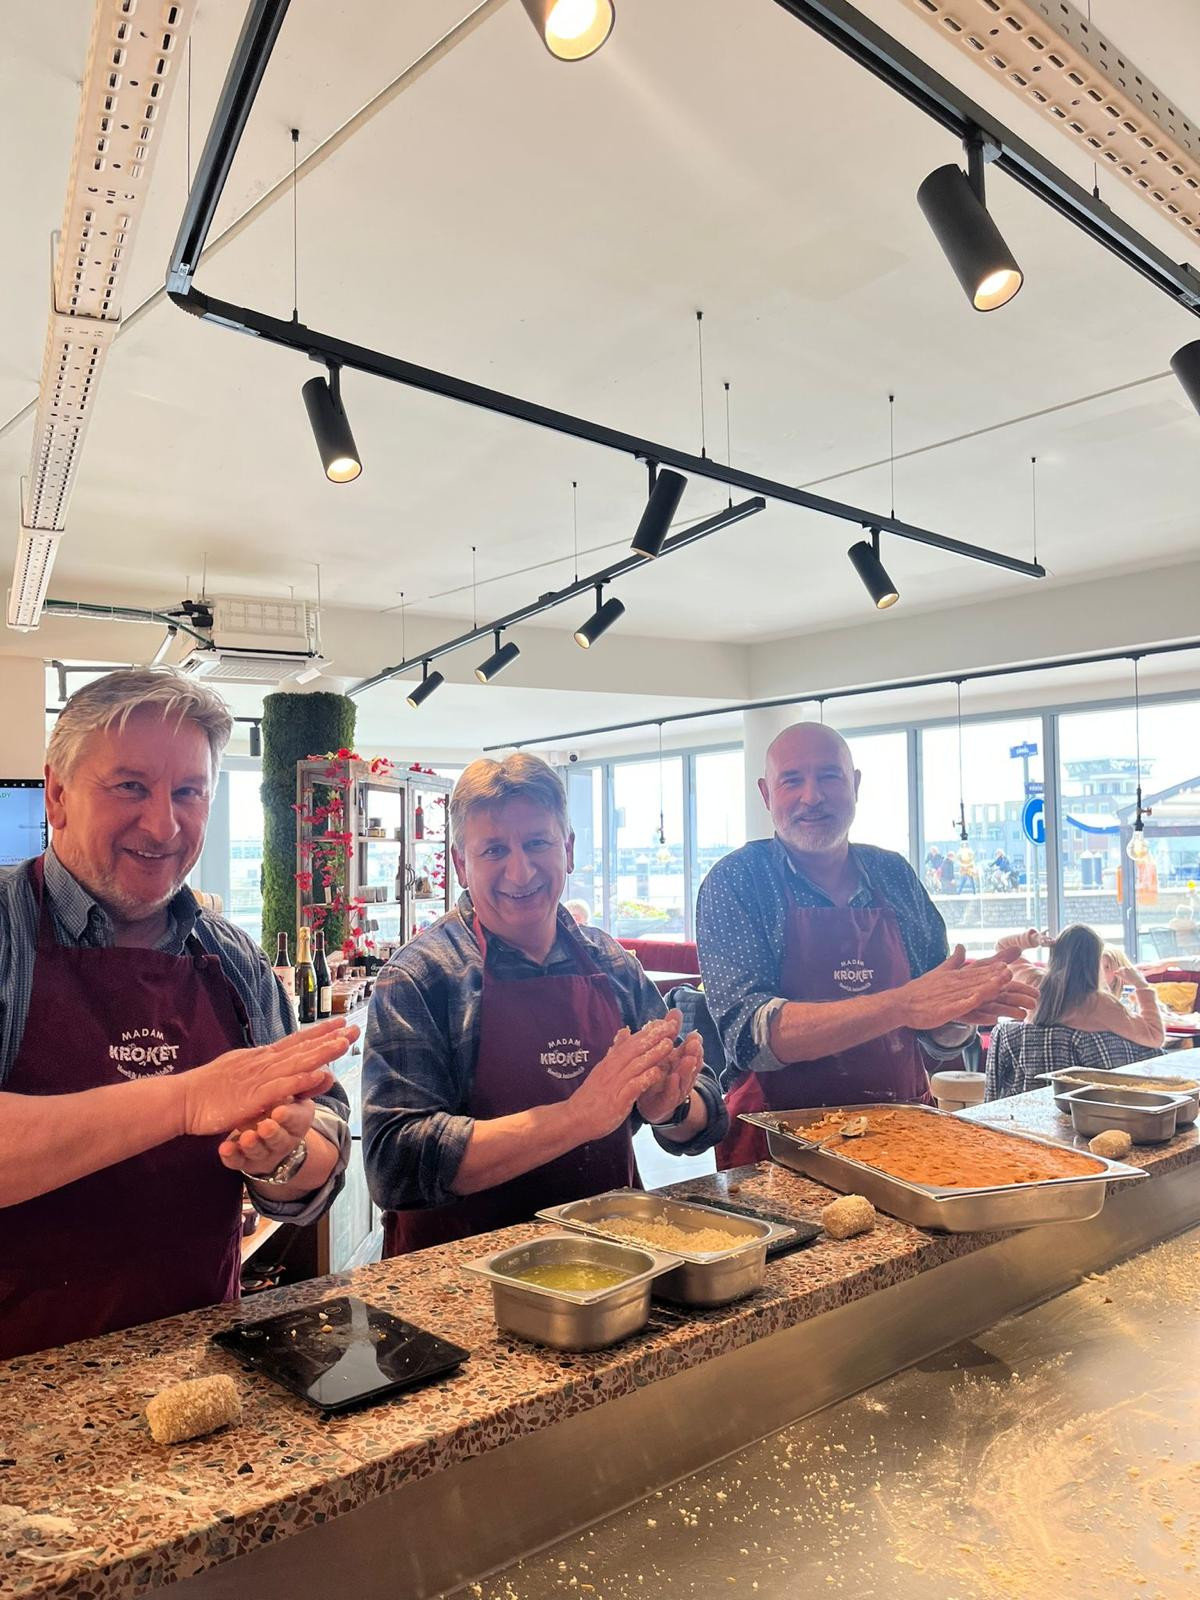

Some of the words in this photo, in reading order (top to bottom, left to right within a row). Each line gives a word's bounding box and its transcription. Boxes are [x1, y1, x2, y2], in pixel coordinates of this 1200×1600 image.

[833, 969, 875, 982] KROKET
[121, 1028, 165, 1041] MADAM
[547, 1038, 581, 1048] MADAM
[108, 1044, 180, 1066] KROKET
[540, 1050, 590, 1066] KROKET
